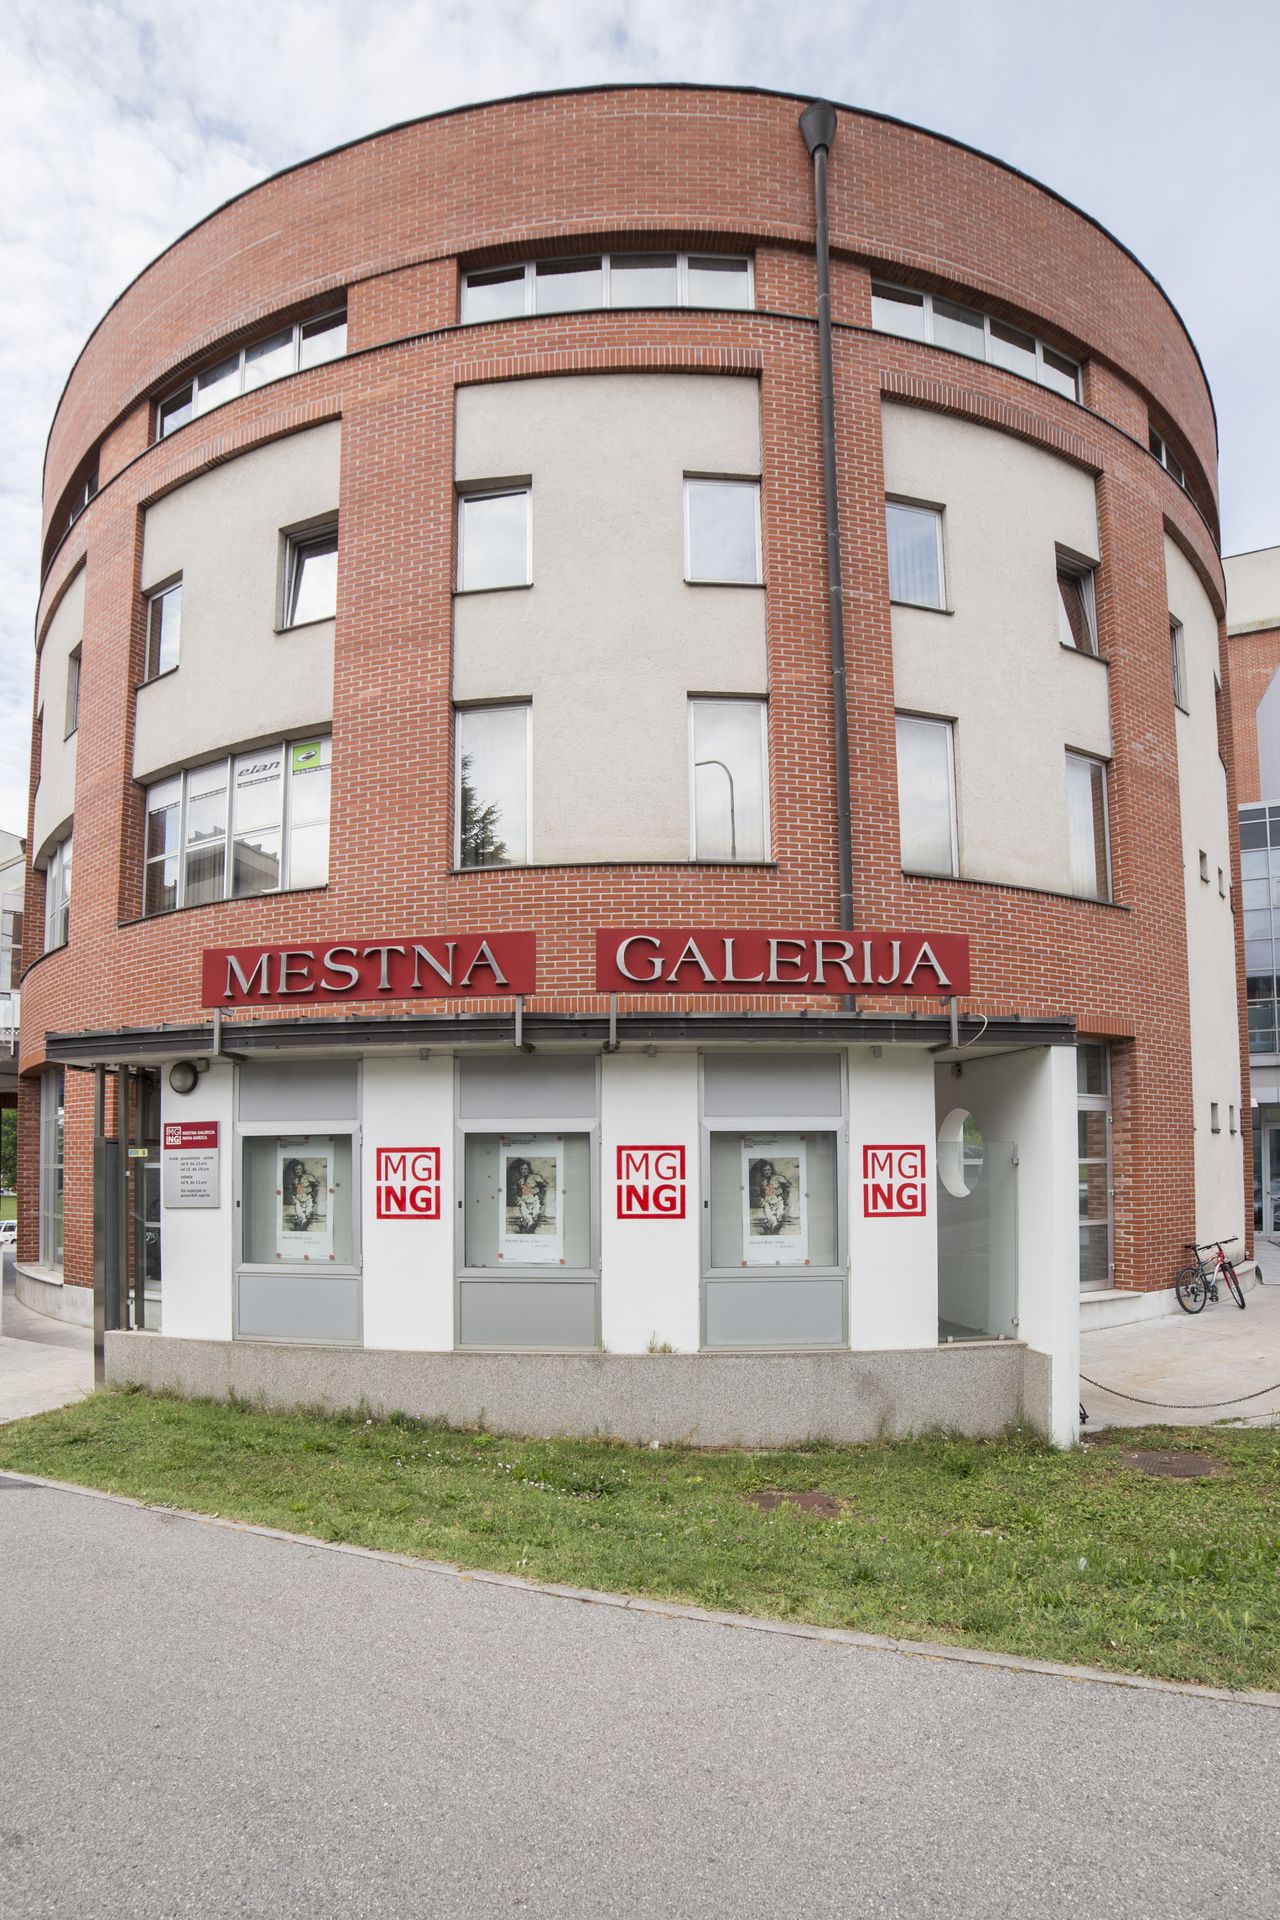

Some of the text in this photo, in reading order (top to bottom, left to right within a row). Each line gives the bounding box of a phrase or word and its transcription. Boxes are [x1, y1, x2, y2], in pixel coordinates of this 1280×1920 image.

[239, 761, 280, 776] elan
[223, 935, 953, 998] MESTNA GALERIJA
[385, 1154, 432, 1182] MG
[626, 1152, 676, 1180] MG
[871, 1152, 918, 1179] MG
[385, 1185, 432, 1212] NG
[626, 1184, 676, 1212] NG
[871, 1183, 918, 1210] NG
